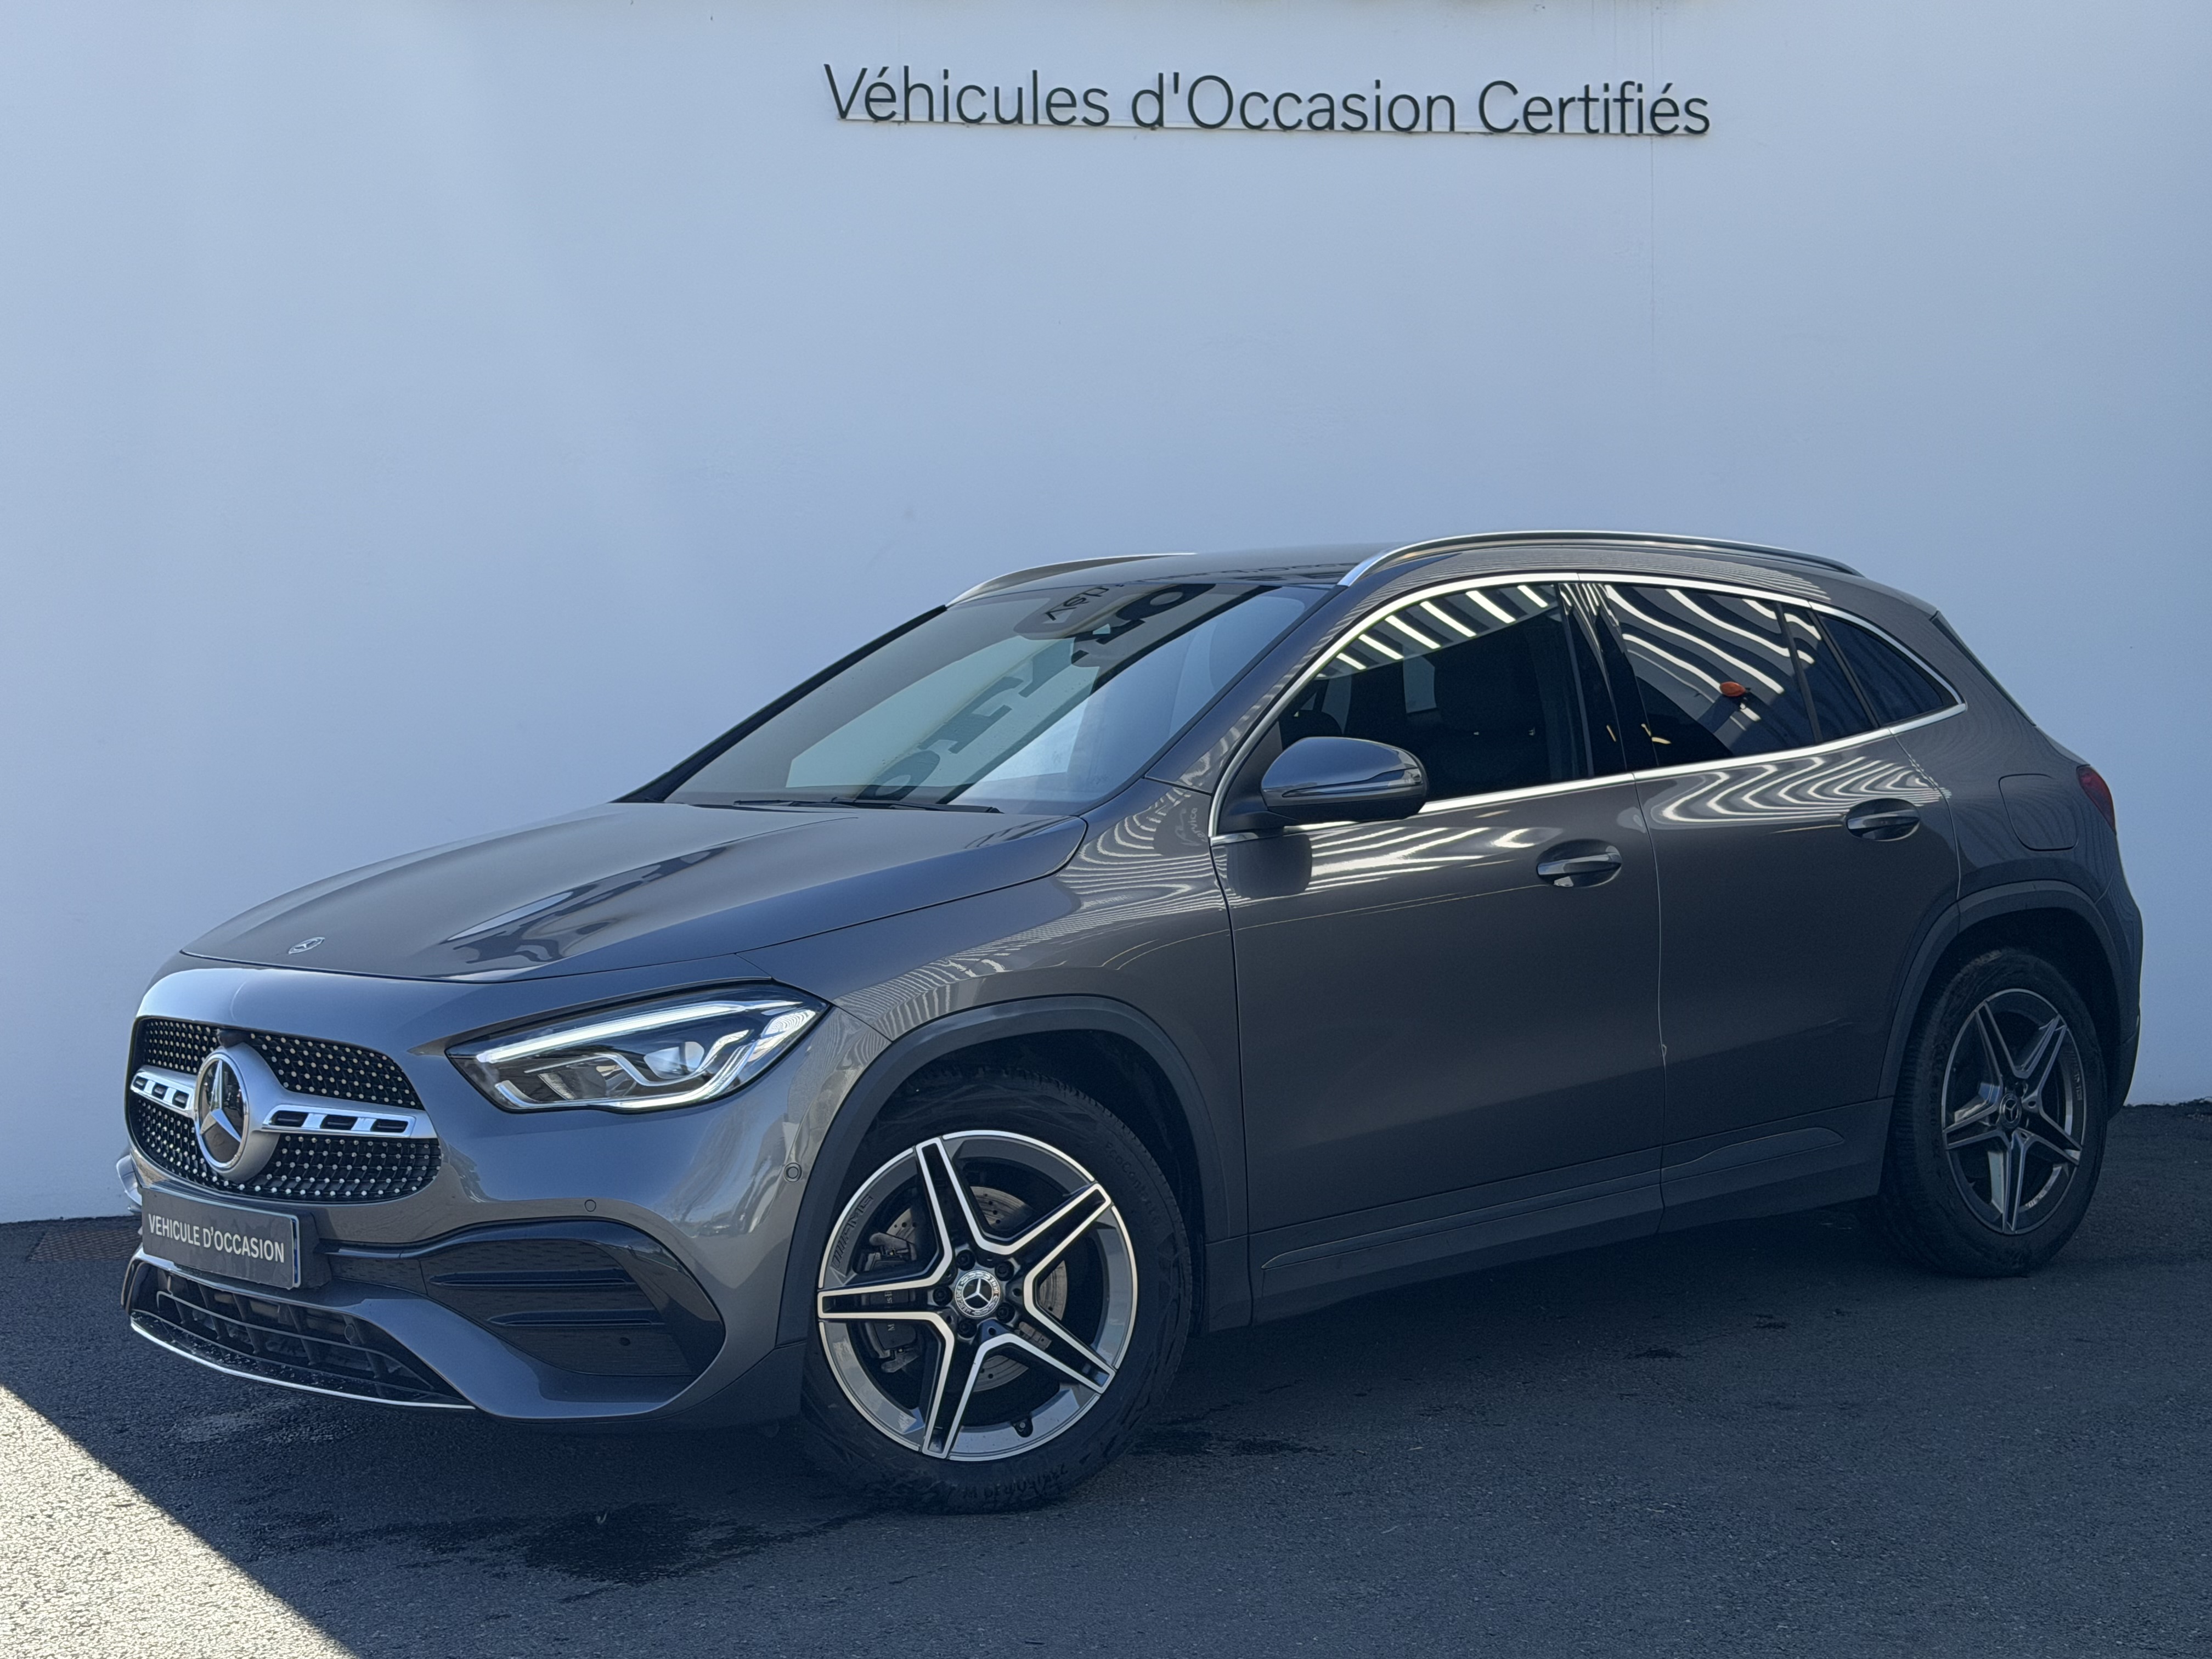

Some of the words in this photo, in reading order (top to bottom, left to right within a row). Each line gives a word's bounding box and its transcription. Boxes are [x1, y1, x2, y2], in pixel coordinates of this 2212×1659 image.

[823, 64, 1110, 128] Véhicules
[1131, 72, 1455, 134] d'Occasion
[1478, 80, 1711, 137] Certifiés
[148, 1214, 201, 1246] VEHICULE
[202, 1226, 285, 1263] D'OCCASION
[956, 1285, 972, 1313] MERCEDES
